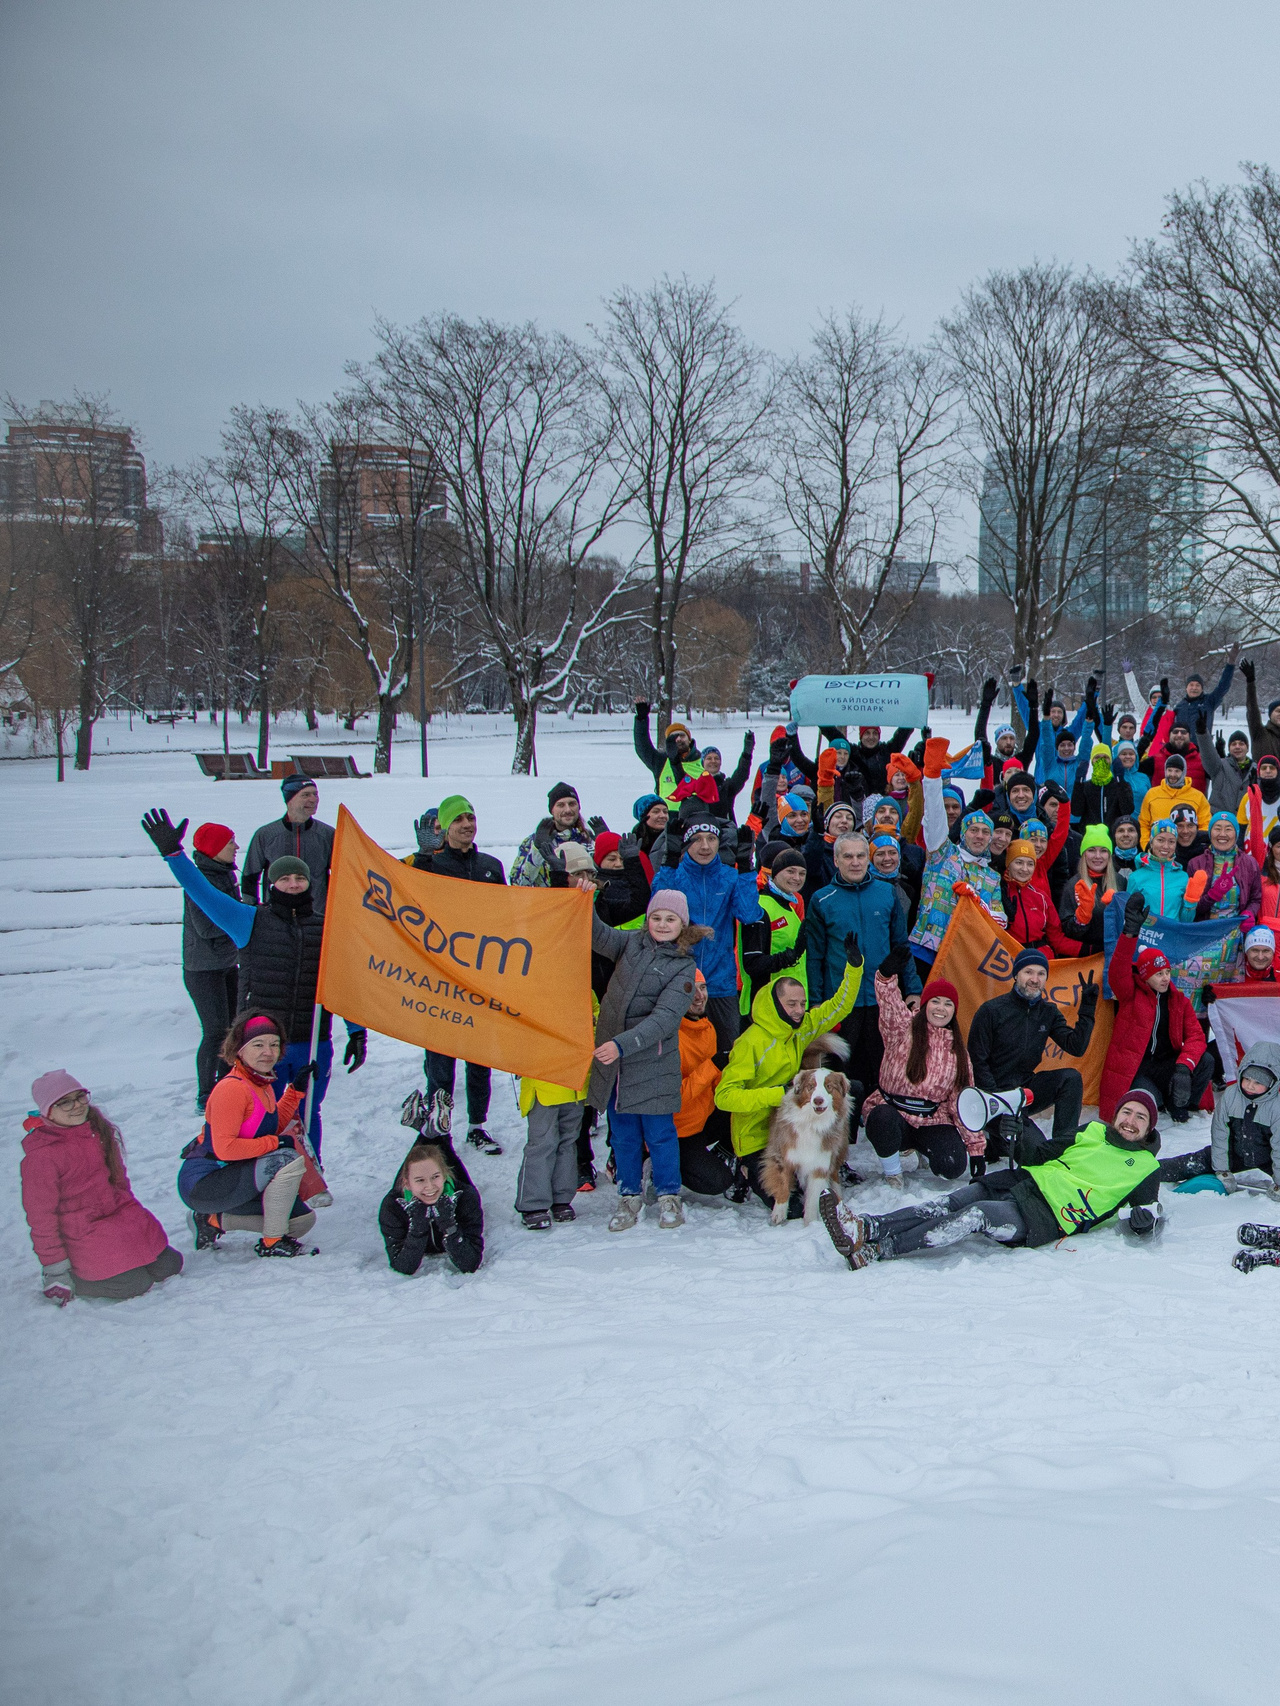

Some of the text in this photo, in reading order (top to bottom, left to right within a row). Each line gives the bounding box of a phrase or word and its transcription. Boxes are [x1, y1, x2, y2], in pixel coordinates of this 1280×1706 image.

[825, 697, 900, 705] ГУБАЙЛОВСКИЙ
[1140, 927, 1164, 940] EAM
[401, 996, 475, 1027] МОСКВА
